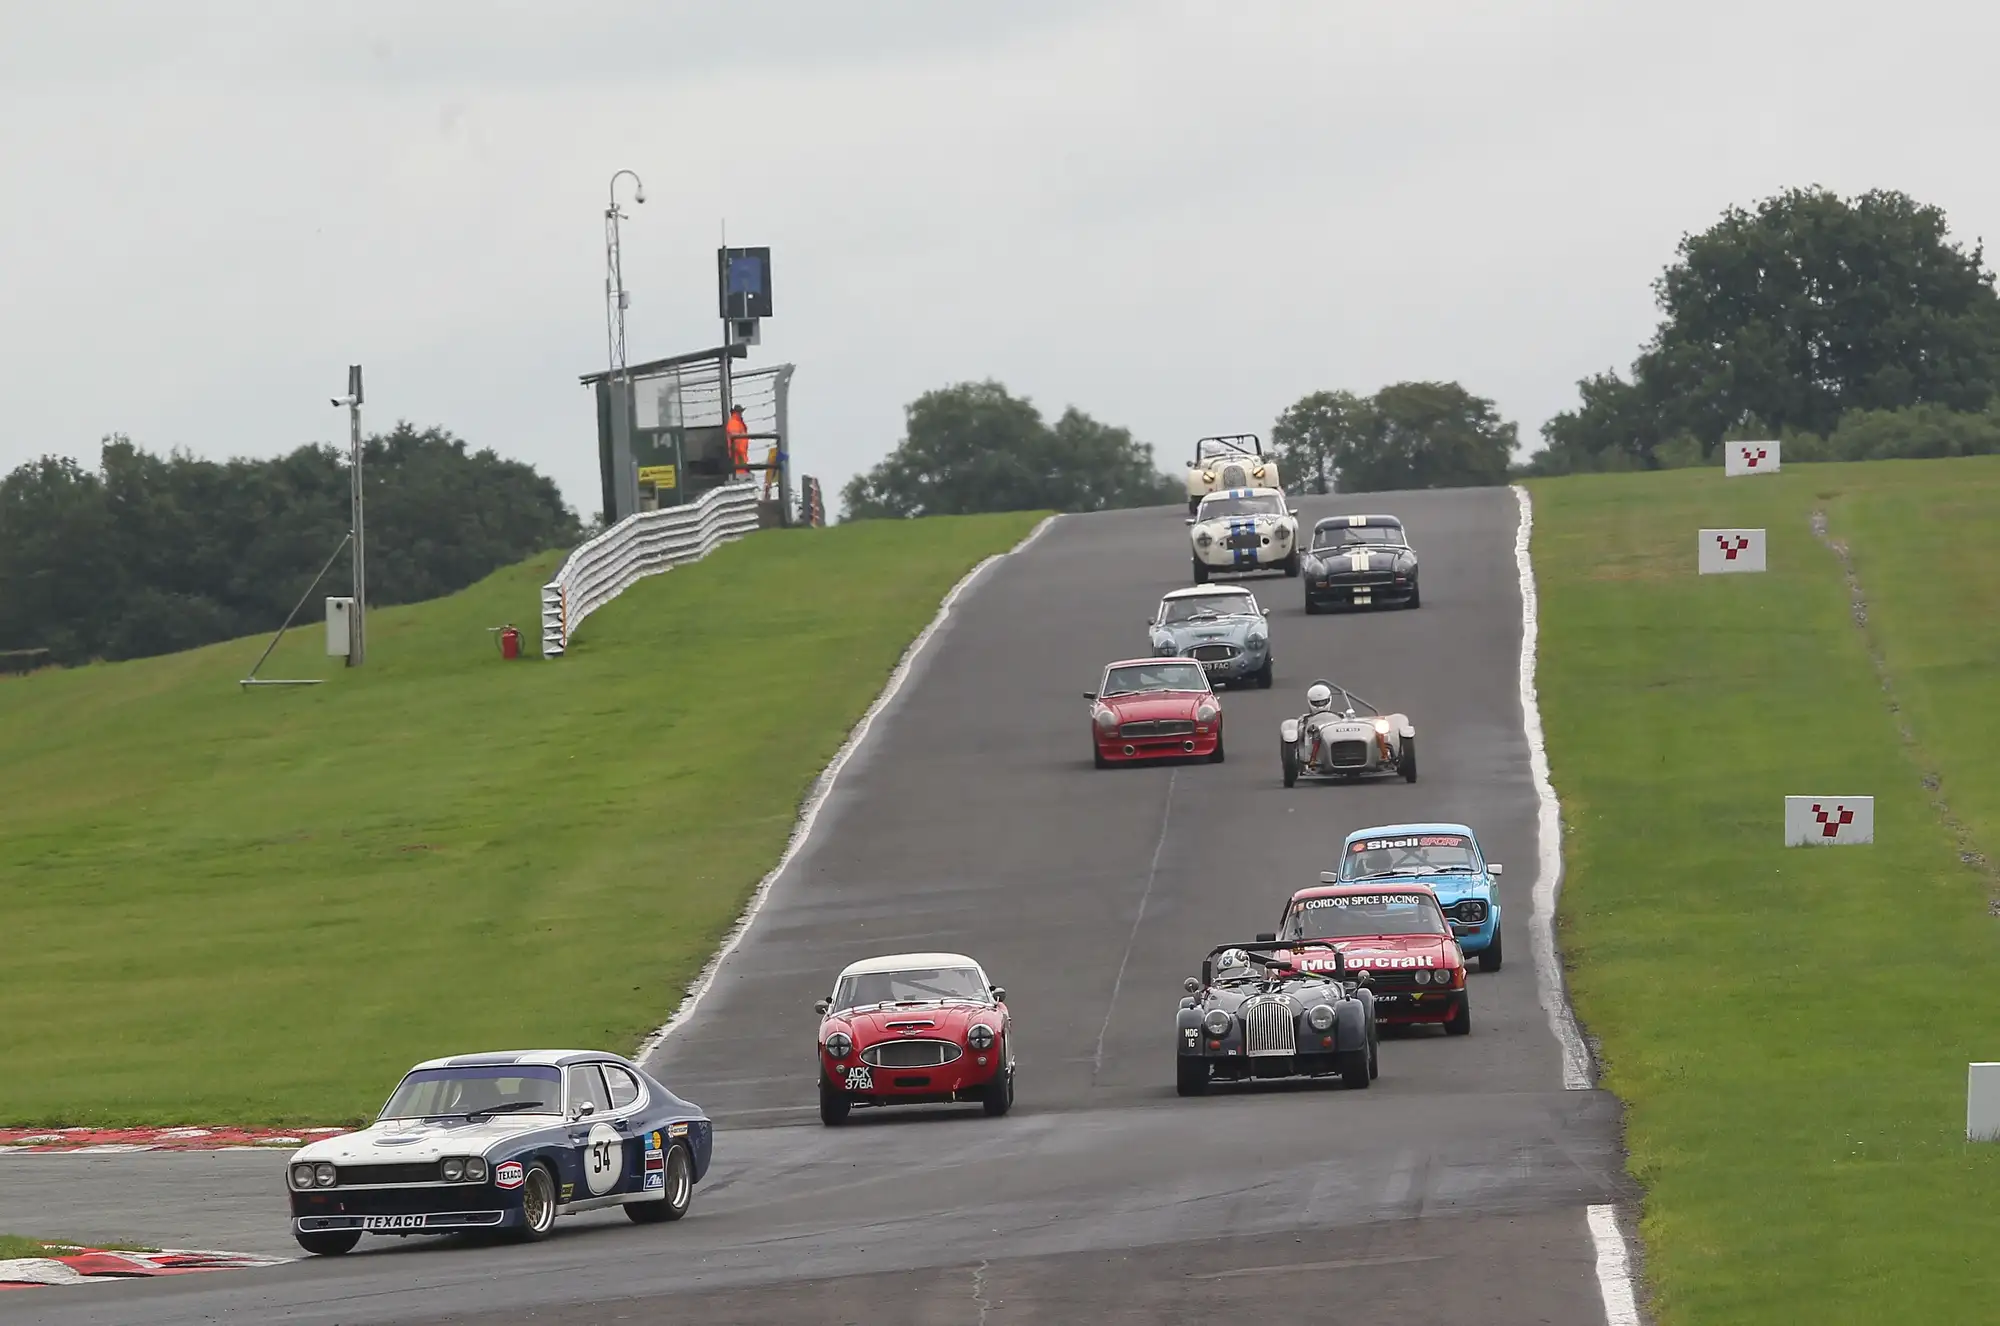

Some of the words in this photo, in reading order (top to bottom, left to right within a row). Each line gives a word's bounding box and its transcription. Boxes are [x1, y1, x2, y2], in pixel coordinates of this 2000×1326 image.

[652, 433, 672, 448] 14
[1367, 838, 1418, 850] Shell
[1420, 837, 1463, 847] SPORT
[1306, 898, 1349, 910] GORDON
[1351, 896, 1380, 905] SPICE
[1382, 895, 1420, 905] RACING
[1301, 955, 1434, 971] Moorcraft
[1184, 1028, 1199, 1038] MOG
[849, 1067, 870, 1078] ACK
[845, 1078, 873, 1089] 376A
[593, 1140, 611, 1173] 54
[498, 1169, 521, 1181] TEXACO
[366, 1216, 423, 1228] TEXACO
